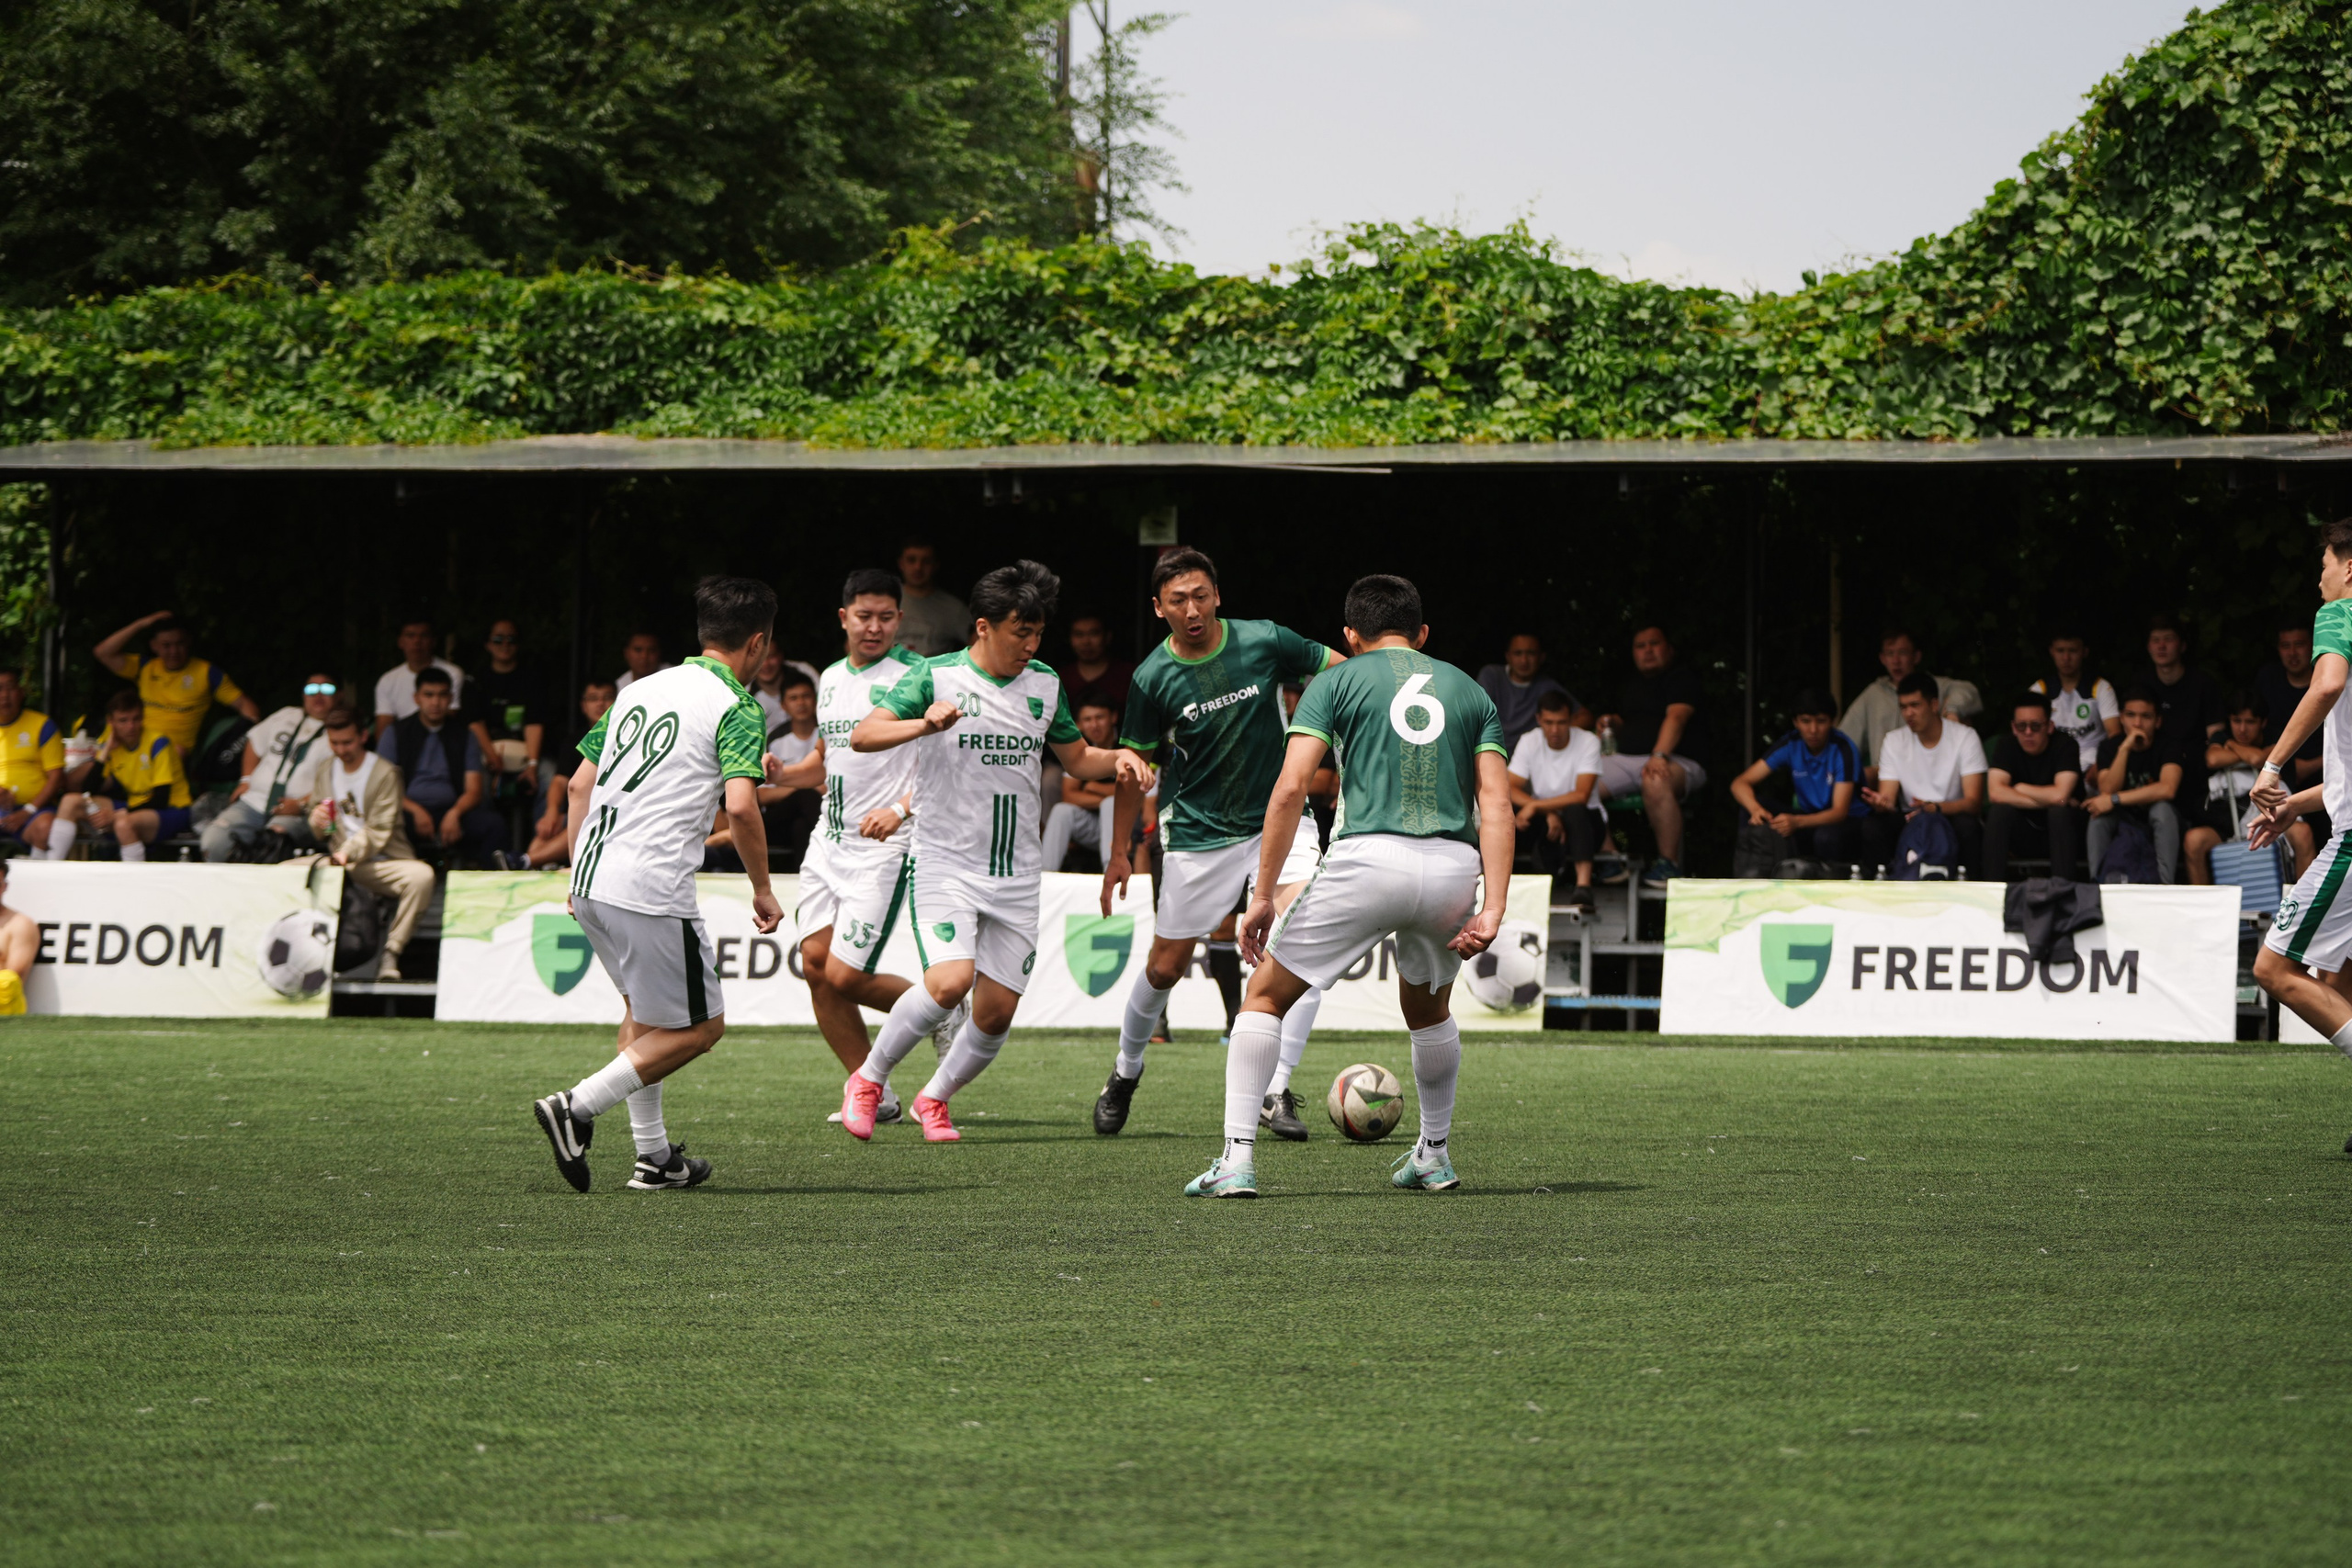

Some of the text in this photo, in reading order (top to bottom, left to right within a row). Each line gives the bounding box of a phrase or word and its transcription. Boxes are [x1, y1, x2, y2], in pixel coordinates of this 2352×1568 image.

[956, 693, 981, 717] 20
[1200, 684, 1260, 715] FREEDOM
[1389, 672, 1445, 745] 6
[597, 705, 680, 793] 99
[958, 734, 1043, 752] FREEDOM
[981, 753, 1029, 766] CREDIT
[33, 922, 223, 968] EEDOM
[1851, 945, 2140, 994] FREEDOM
